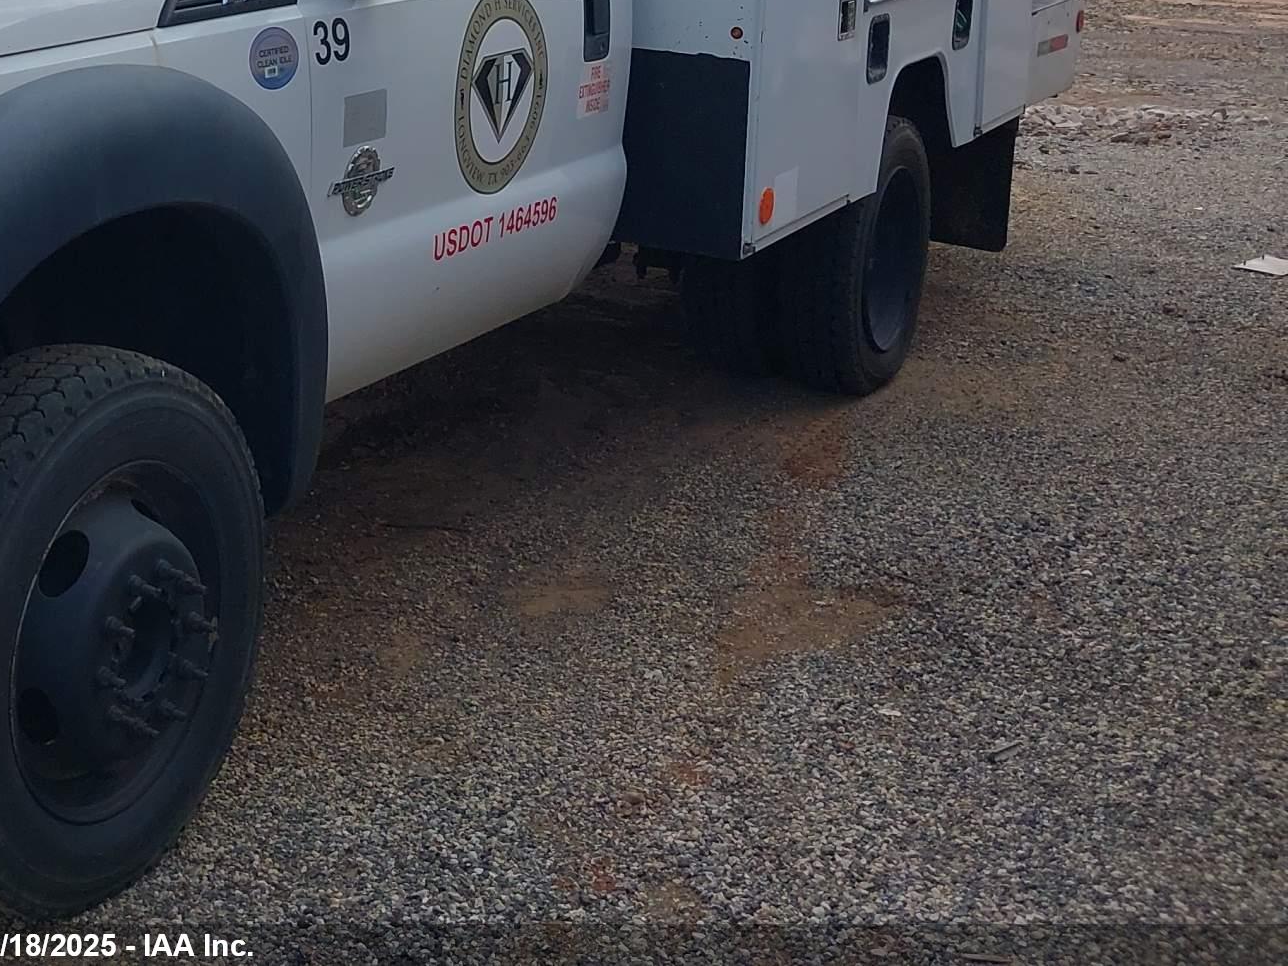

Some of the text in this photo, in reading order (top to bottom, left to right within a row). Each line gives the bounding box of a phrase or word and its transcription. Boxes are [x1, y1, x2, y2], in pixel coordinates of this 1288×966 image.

[257, 57, 278, 68] CLEAN
[312, 16, 352, 67] 39
[459, 1, 493, 82] DIAMOND
[493, 60, 515, 106] H
[457, 115, 484, 185] LONGVIEW
[433, 196, 558, 261] USDOT 1464596
